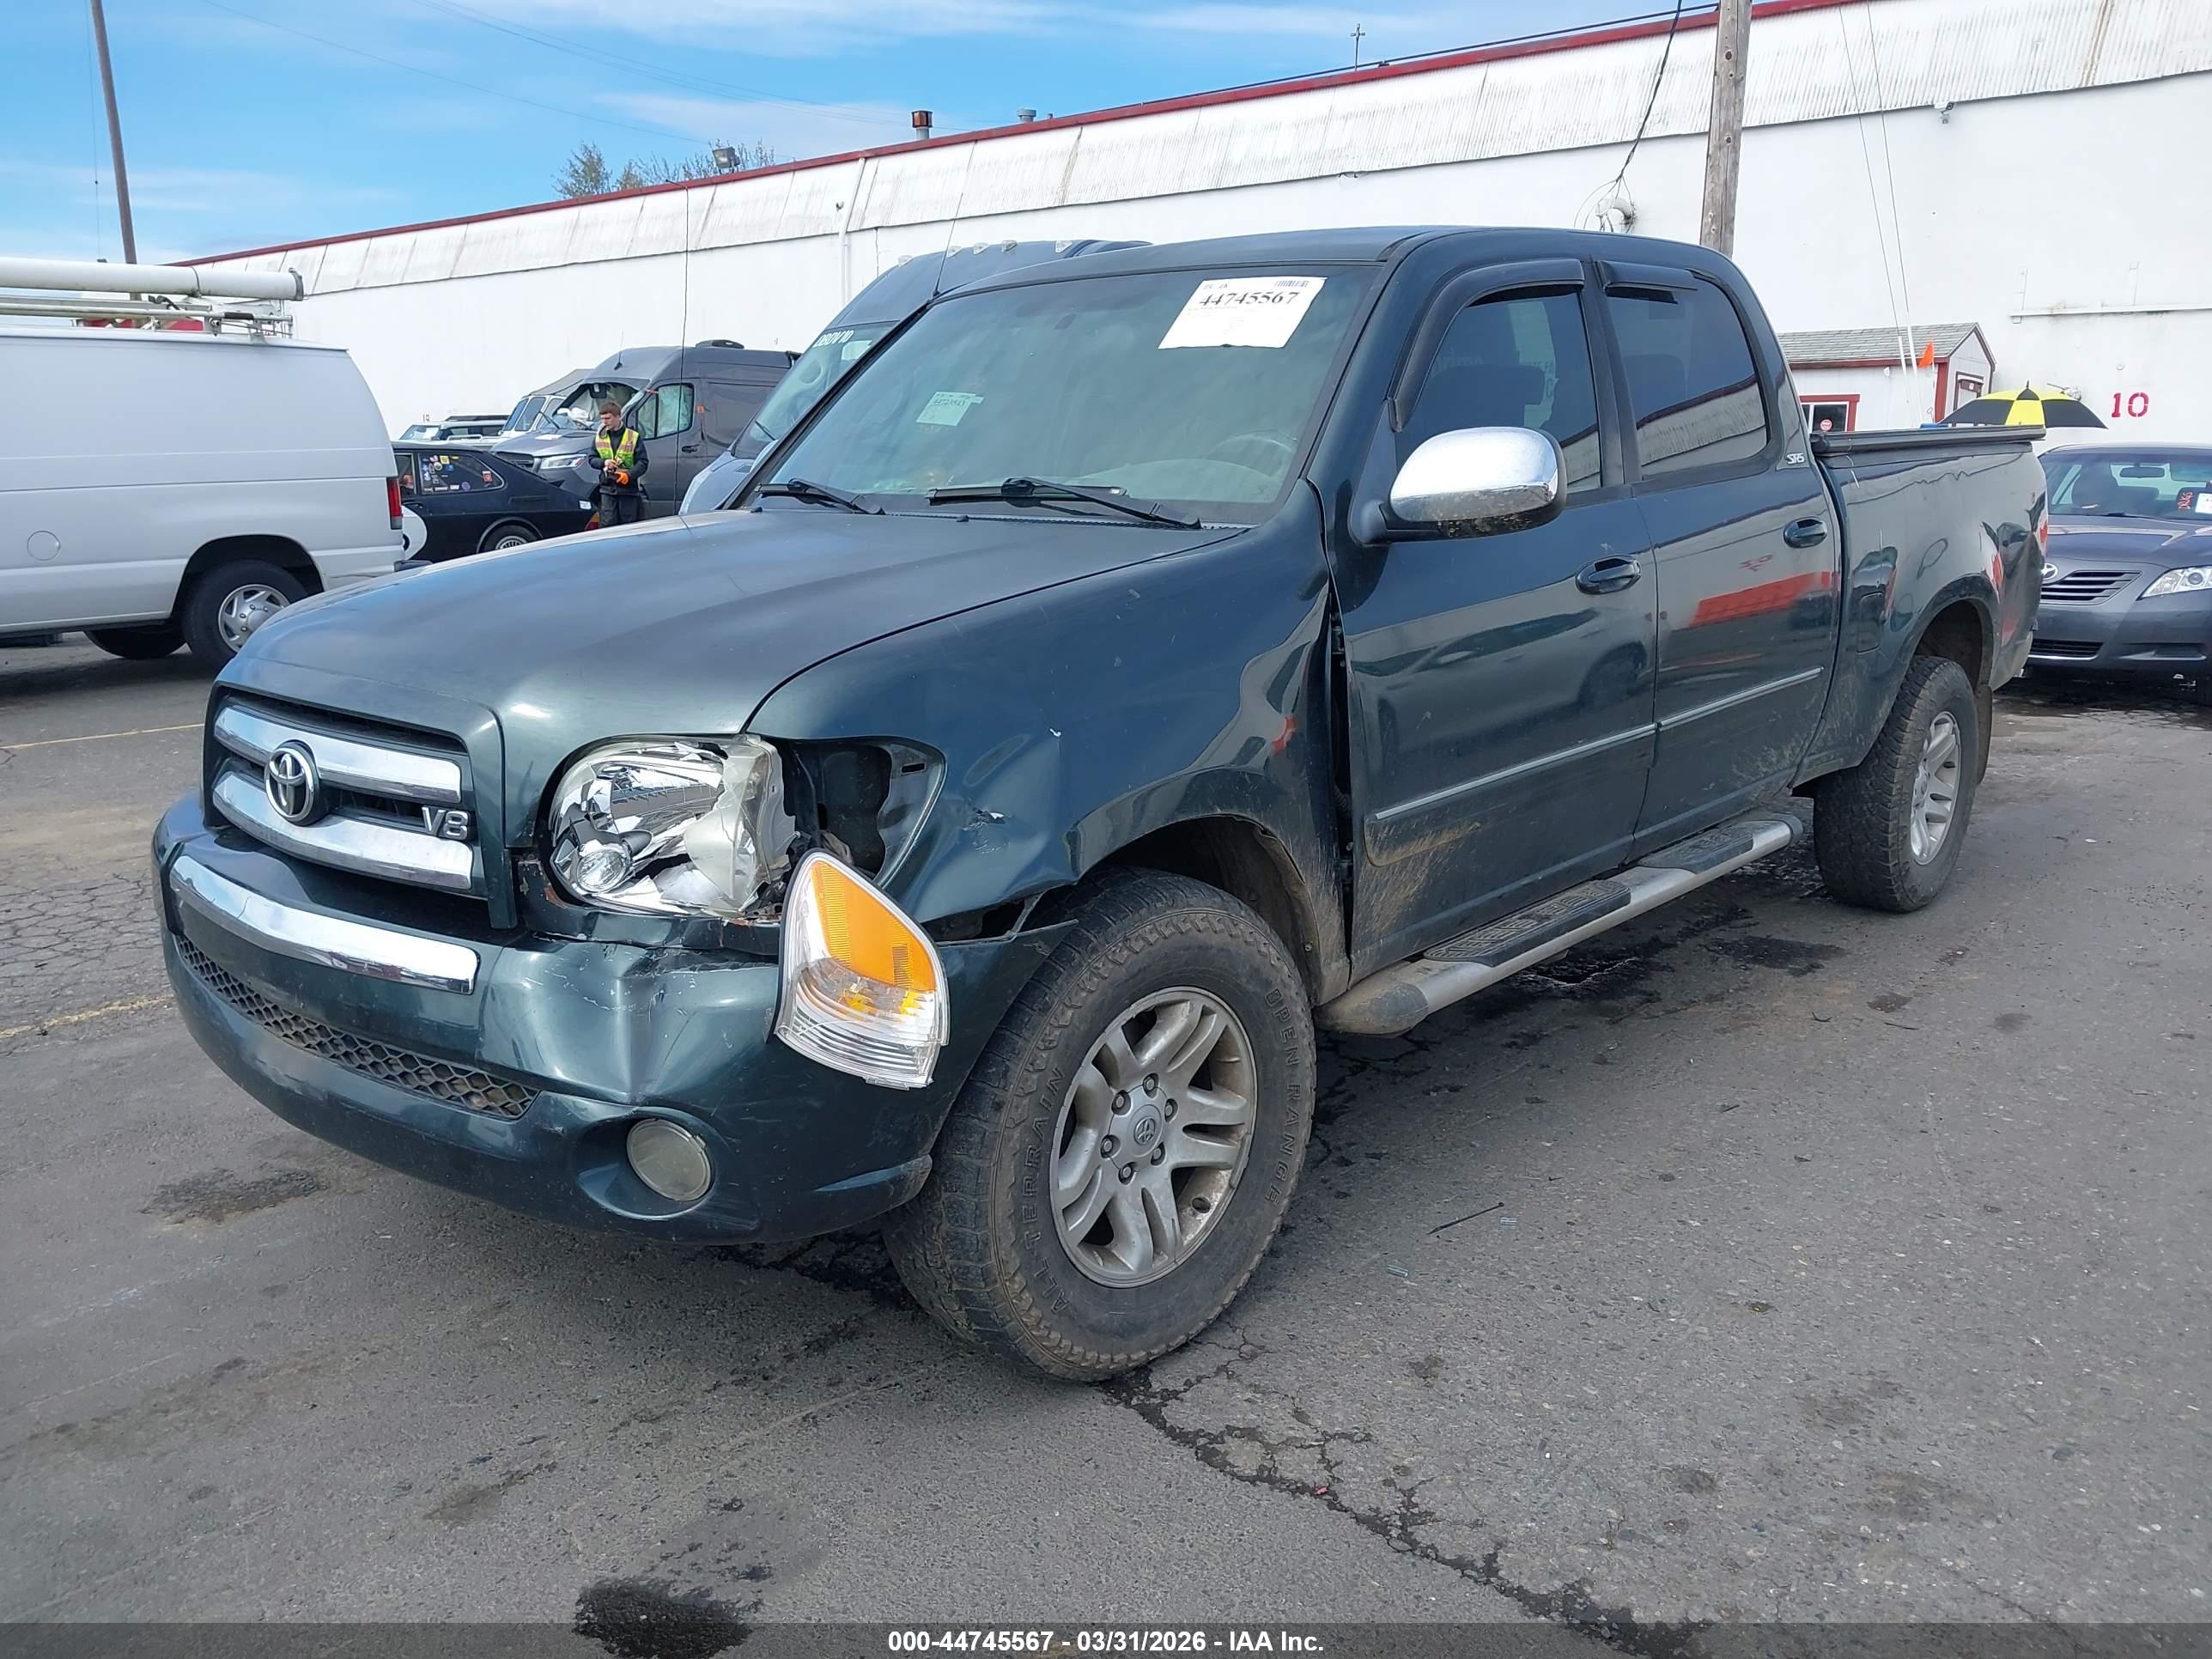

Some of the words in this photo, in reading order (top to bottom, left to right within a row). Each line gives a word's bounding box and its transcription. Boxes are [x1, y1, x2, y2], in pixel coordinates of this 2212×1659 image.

[1199, 291, 1301, 307] 44745567
[2111, 392, 2150, 418] 10
[421, 805, 470, 841] V8
[1264, 988, 1301, 1066] OPEN
[1022, 1065, 1066, 1250] TERRAIN
[1264, 1084, 1303, 1206] RANGE
[1033, 1256, 1071, 1315] ALL
